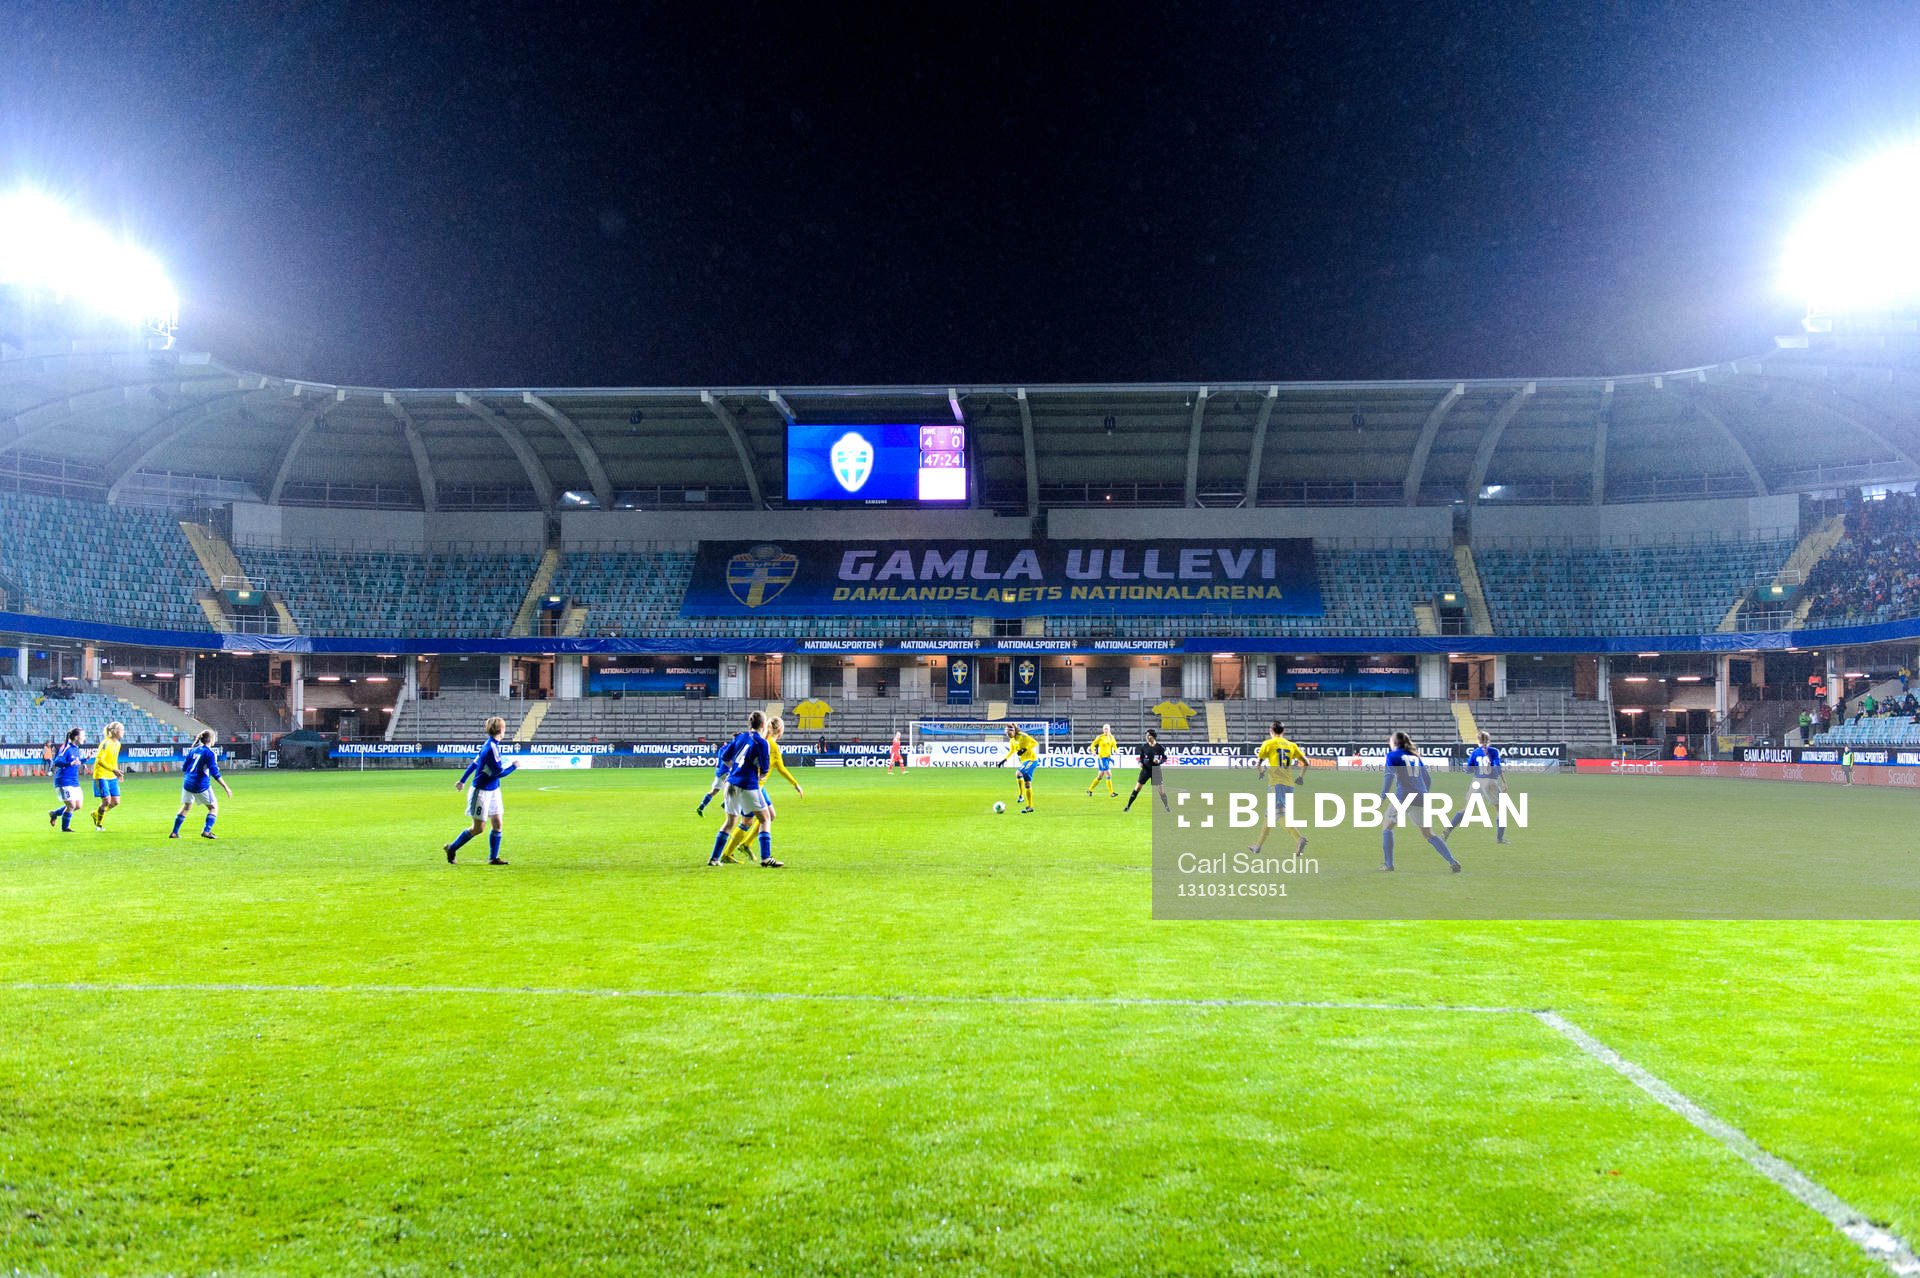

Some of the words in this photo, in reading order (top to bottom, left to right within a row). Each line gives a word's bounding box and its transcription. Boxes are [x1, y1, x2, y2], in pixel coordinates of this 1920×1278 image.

[924, 436, 933, 448] 4
[951, 435, 960, 448] 0
[924, 453, 960, 467] 47:24
[836, 548, 1044, 581] GAMLA
[1064, 548, 1277, 581] ULLEVI
[832, 584, 1063, 603] DAMLANDSLAGETS
[1070, 585, 1283, 601] NATIONALARENA
[804, 640, 877, 649] NATIONALSPORTEN
[901, 640, 974, 649] NATIONALSPORTEN
[998, 640, 1071, 649] NATIONALSPORTEN
[1095, 640, 1168, 649] NATIONALSPORTEN
[600, 667, 650, 675] NATIONALSPORTEN
[1287, 667, 1340, 675] NATIONALSPORTEN
[128, 747, 170, 758] NATIONALSPORTEN
[338, 744, 414, 753] NATIONALSPORTEN
[436, 744, 514, 753] NATIONALSTEN
[530, 744, 608, 753] NATIONALSPORTEN
[633, 744, 710, 754] NATIONALSPORTEN
[942, 745, 998, 754] verisure
[1047, 746, 1088, 755] GAMLA
[1202, 747, 1240, 755] ULLEVI
[1307, 747, 1346, 756] ULLEVI
[1520, 747, 1560, 756] ULLEVI
[735, 744, 750, 768] 4
[1277, 748, 1291, 769] 15
[1743, 749, 1765, 762] GAMLA
[1770, 749, 1792, 763] ULLEVI
[190, 753, 201, 773] 7
[845, 756, 892, 767] adidas
[932, 760, 979, 768] SVENSKA
[1401, 754, 1420, 778] 17
[1610, 761, 1663, 774] Scandic
[1739, 763, 1758, 777] Scandic
[1783, 765, 1804, 780] Scandic
[1888, 769, 1917, 785] Scandic
[476, 805, 483, 816] 8
